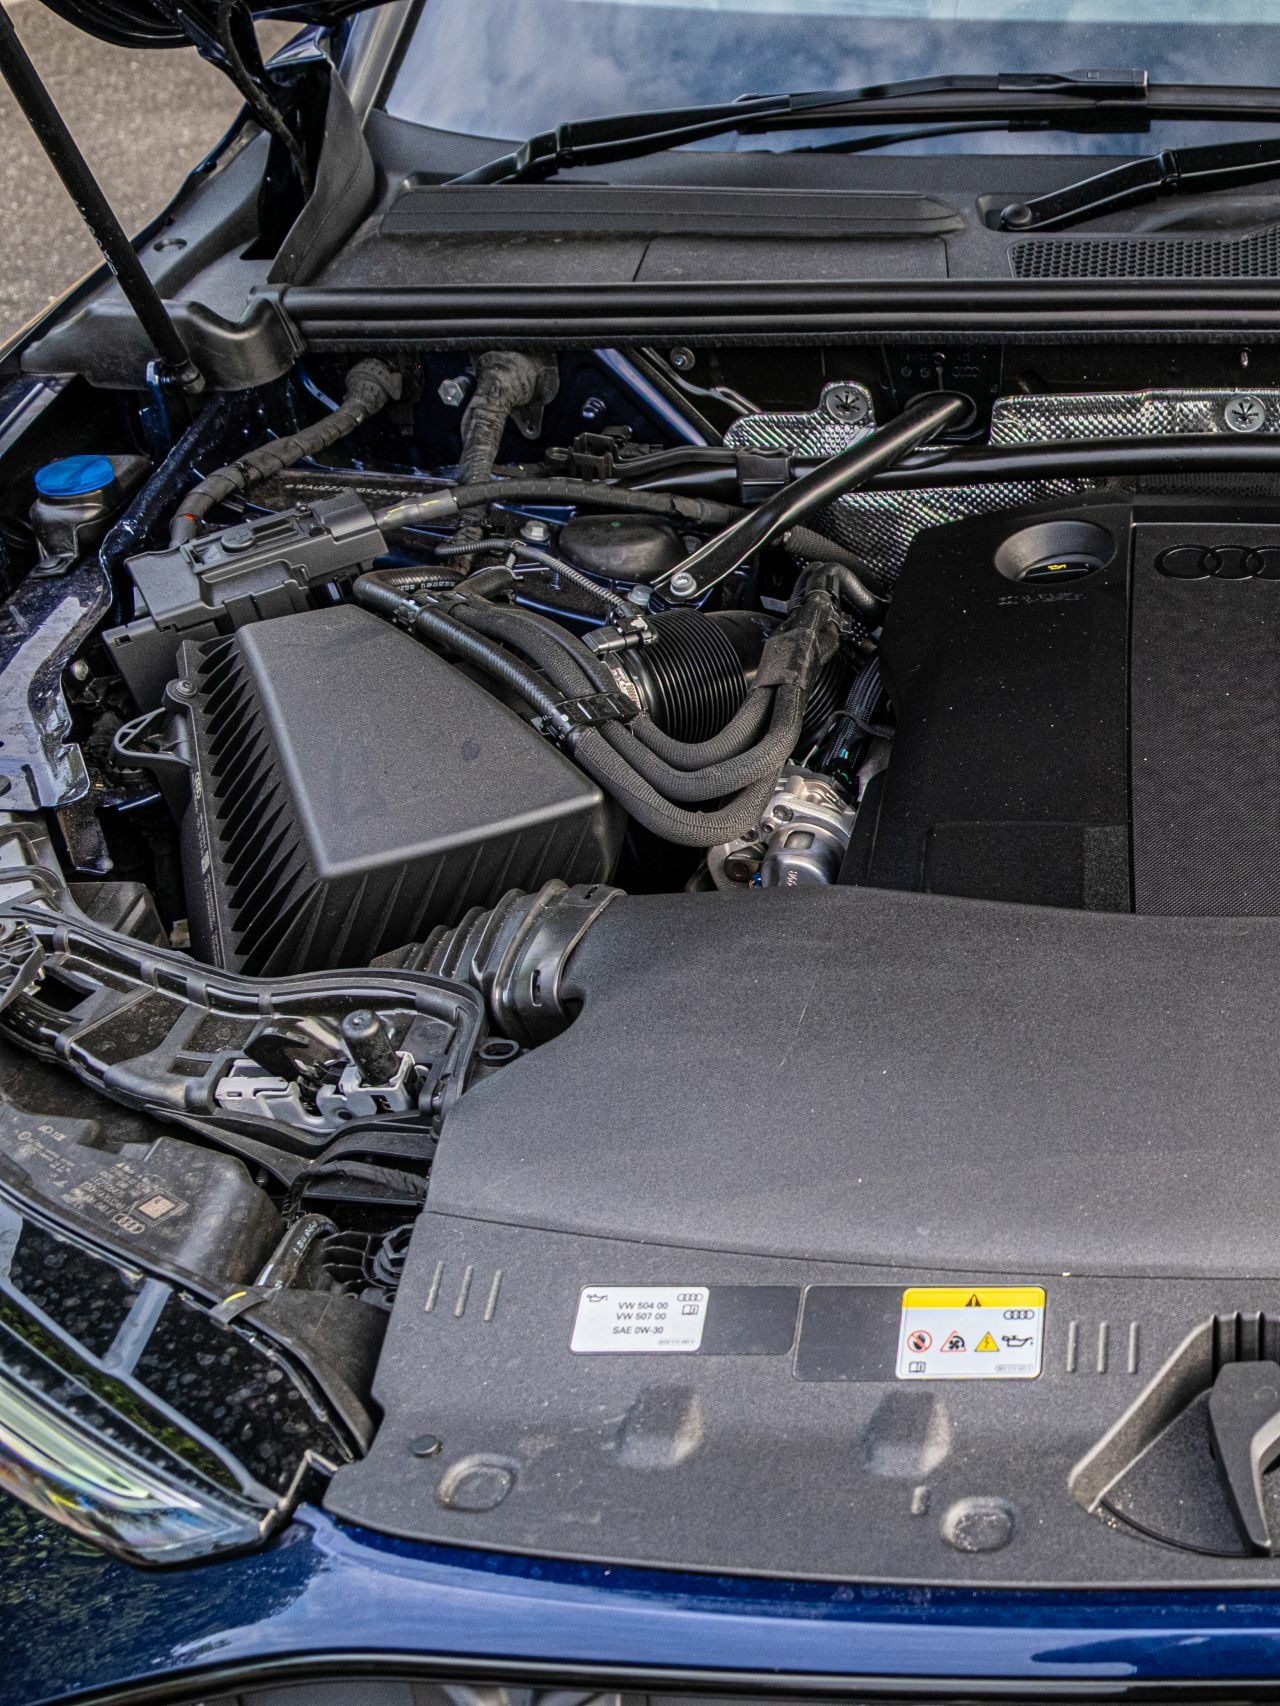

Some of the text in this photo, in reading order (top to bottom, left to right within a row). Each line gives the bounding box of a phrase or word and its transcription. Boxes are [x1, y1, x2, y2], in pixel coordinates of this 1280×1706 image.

[618, 1302, 668, 1310] VW 504 00
[635, 1312, 652, 1320] 507
[655, 1312, 667, 1320] 00
[612, 1326, 664, 1334] SAE 0W-30
